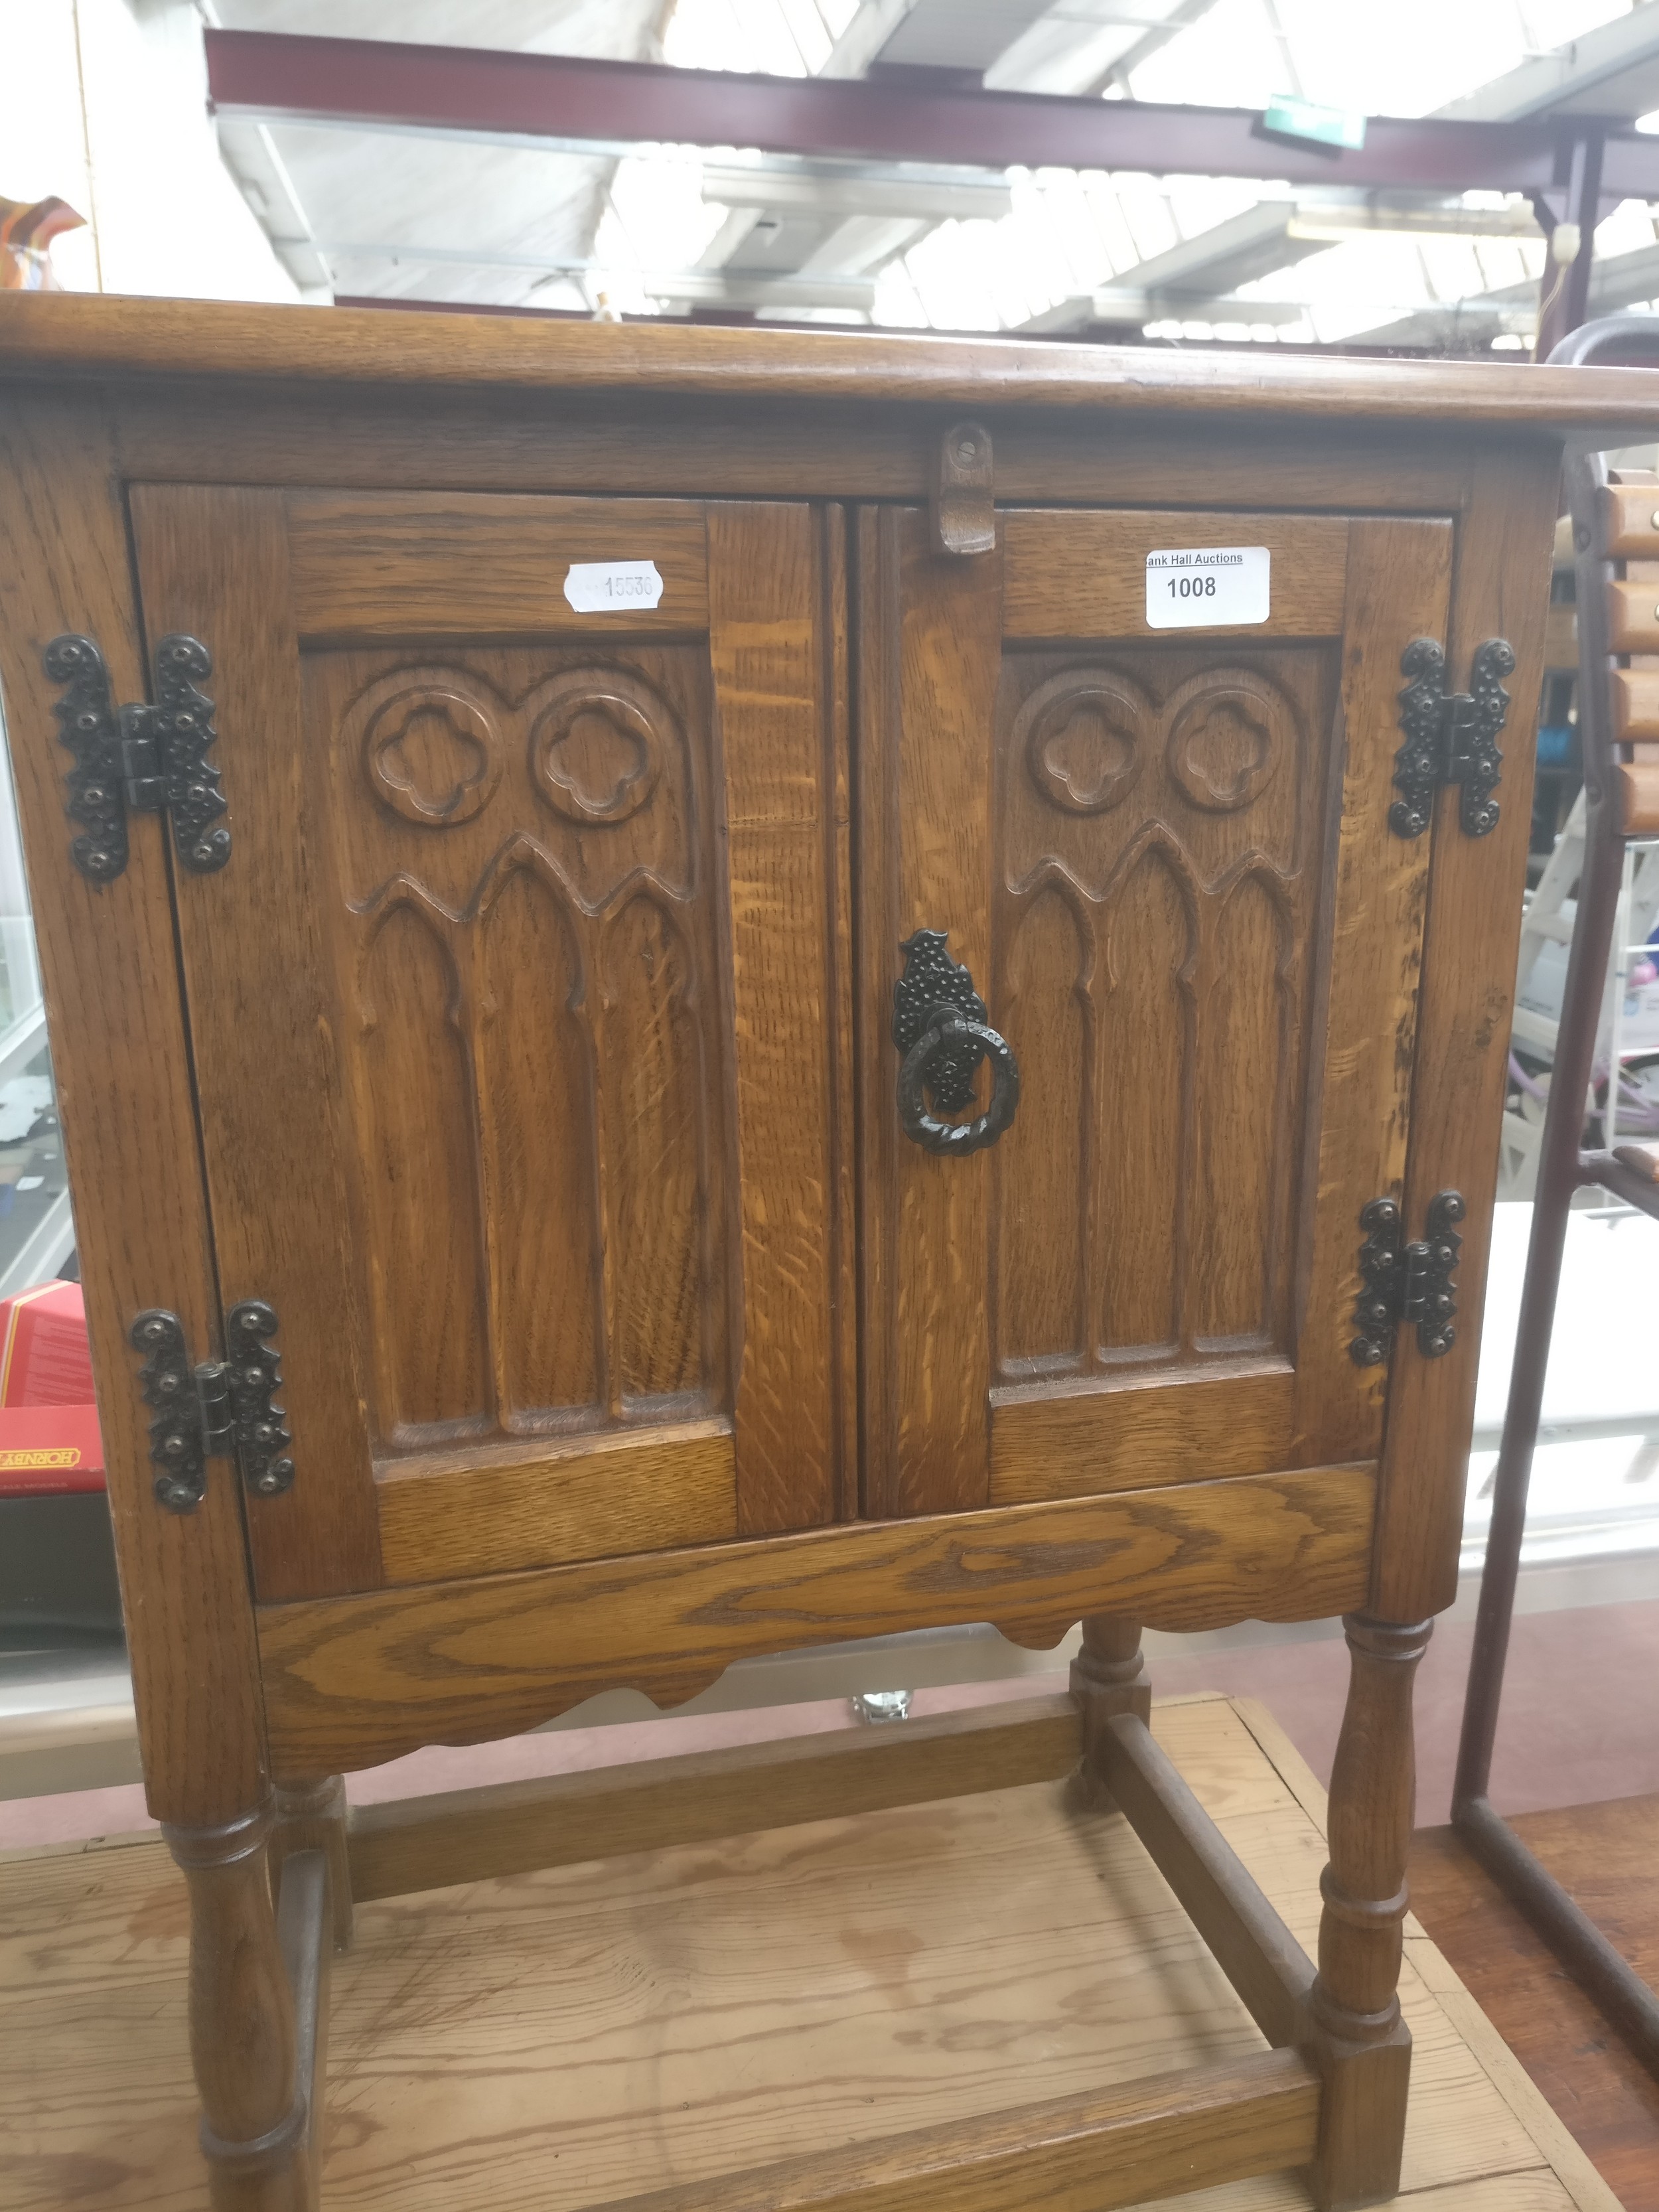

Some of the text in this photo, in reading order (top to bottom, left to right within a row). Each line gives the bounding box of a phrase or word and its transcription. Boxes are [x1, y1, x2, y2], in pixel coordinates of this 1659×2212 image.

[1147, 553, 1243, 566] ank Hall Auctions
[1167, 577, 1216, 598] 1008
[2, 1451, 74, 1466] HORNBY
